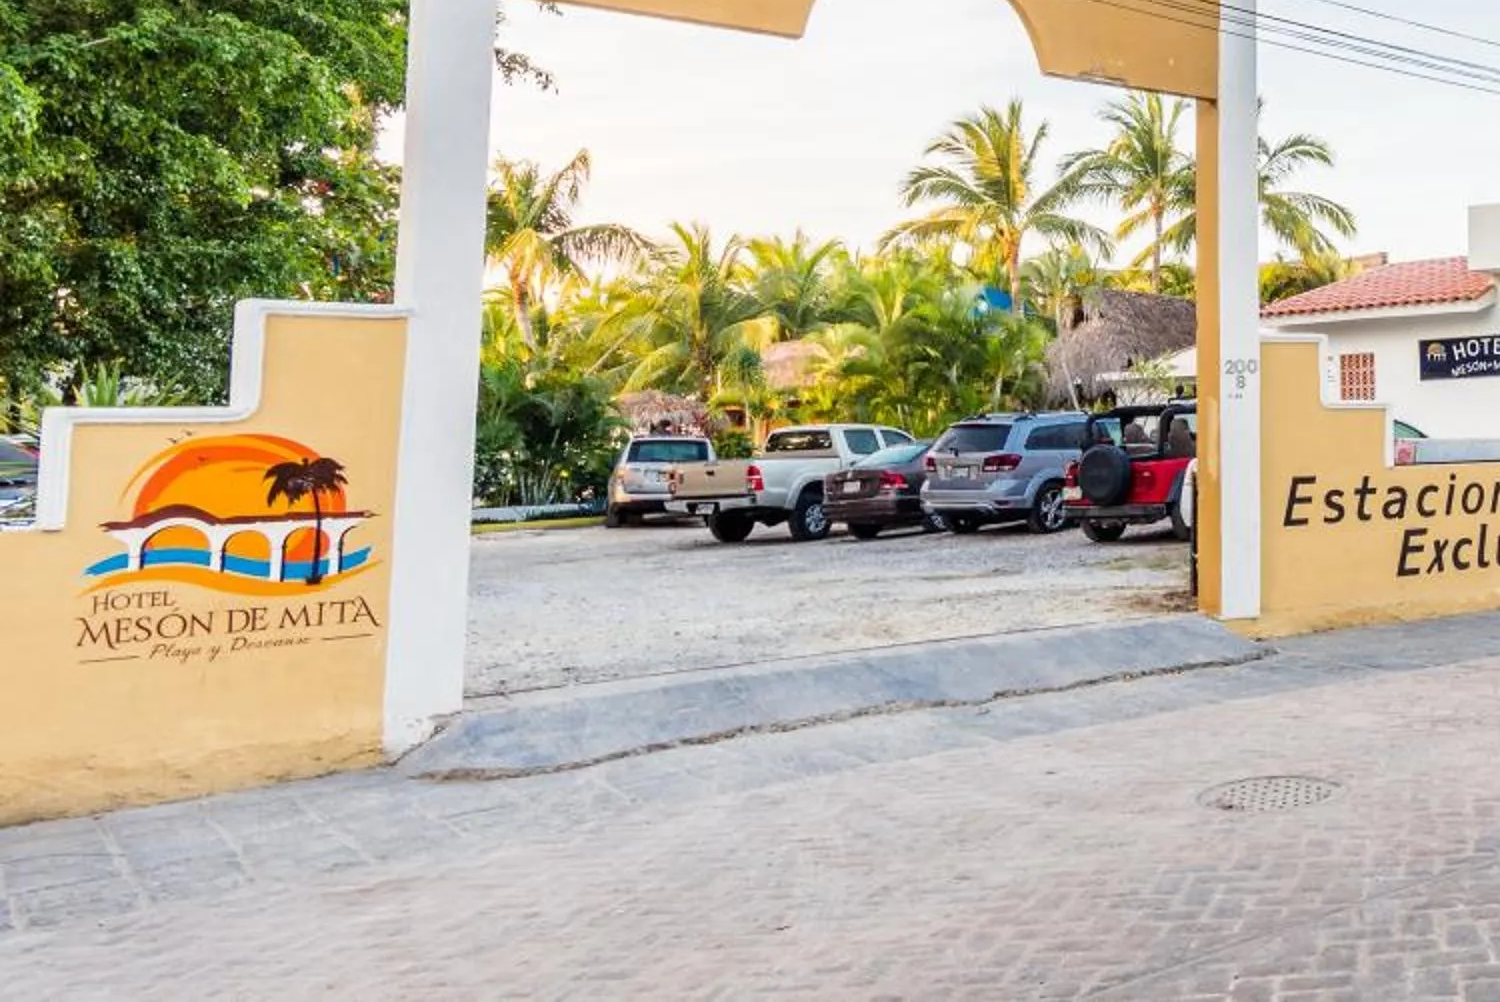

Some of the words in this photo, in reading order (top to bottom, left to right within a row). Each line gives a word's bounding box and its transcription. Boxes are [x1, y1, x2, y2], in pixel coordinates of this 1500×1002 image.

[1224, 359, 1257, 374] 200
[92, 590, 176, 614] HOTEL
[76, 606, 214, 650] MESÓN
[226, 607, 271, 634] DE
[278, 595, 381, 628] MITA
